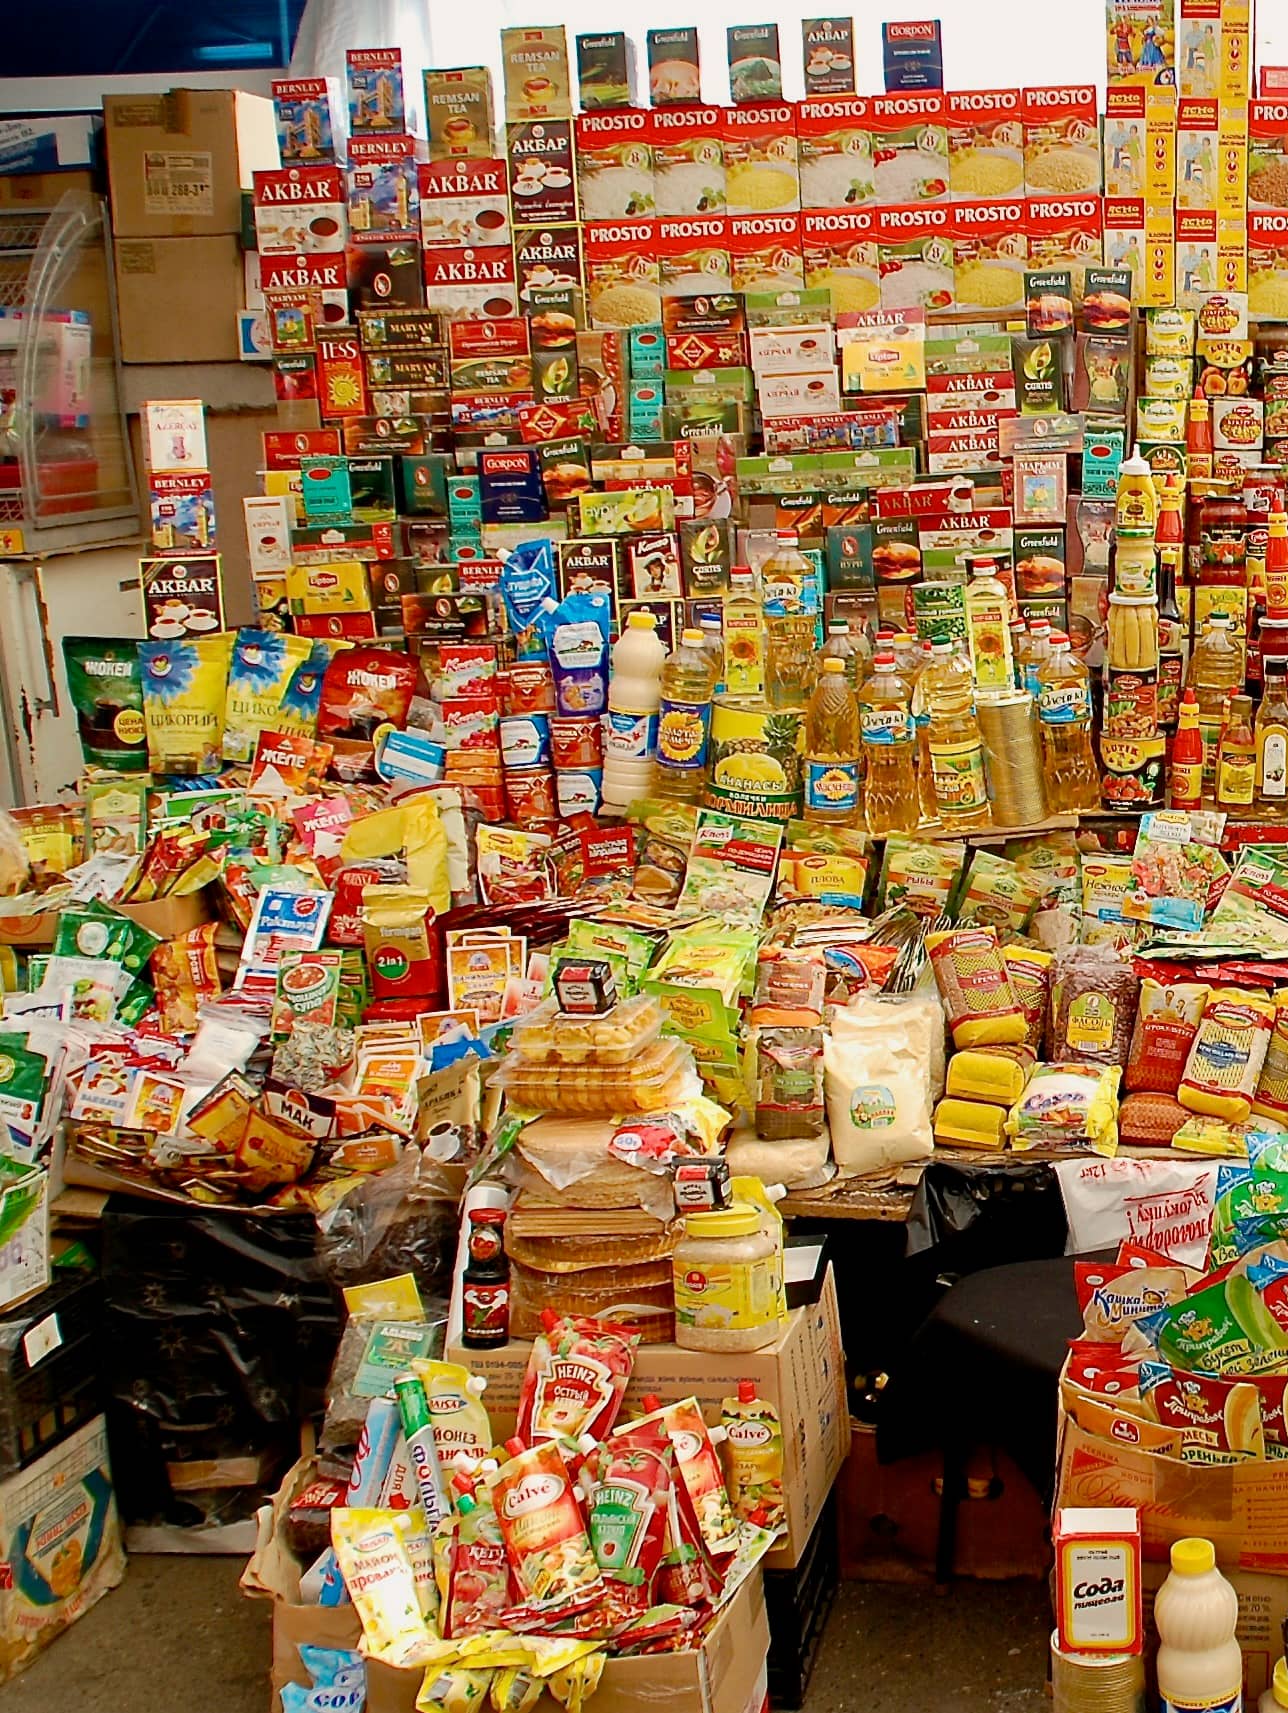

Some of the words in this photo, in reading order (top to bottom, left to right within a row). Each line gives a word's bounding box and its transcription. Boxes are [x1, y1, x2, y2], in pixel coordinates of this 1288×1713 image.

[890, 24, 933, 37] GORDON
[351, 52, 396, 63] BERNLEY
[511, 52, 560, 65] REMSAN
[526, 63, 547, 72] TEA
[276, 83, 321, 95] BERNLEY
[433, 92, 480, 104] REMSAN
[950, 94, 1017, 110] PROSTO
[1026, 89, 1094, 107] PROSTO
[448, 104, 468, 113] TEA
[801, 102, 867, 120] PROSTO
[874, 98, 941, 116] PROSTO
[654, 109, 717, 127] PROSTO
[727, 107, 791, 125] PROSTO
[583, 116, 645, 132] PROSTO
[351, 142, 410, 155] BERNLEY
[427, 172, 499, 193] AKBAR
[262, 180, 331, 201] AKBAR
[881, 209, 947, 226] PROSTO
[955, 207, 1022, 224] PROSTO
[1030, 201, 1096, 219] PROSTO
[661, 221, 724, 238] PROSTO
[732, 217, 797, 235] PROSTO
[805, 214, 872, 232] PROSTO
[590, 225, 653, 243] PROSTO
[519, 245, 577, 259] AKBAR
[269, 268, 338, 288] AKBAR
[434, 262, 509, 280] AKBAR
[1029, 275, 1066, 288] Greenfield
[1090, 273, 1127, 286] Greenfield
[857, 312, 907, 325] AKBAR
[321, 341, 357, 358] TESS
[947, 377, 996, 391] AKBAR
[949, 414, 999, 428] AKBAR
[681, 425, 724, 437] Greenfield
[949, 438, 999, 452] AKBAR
[487, 457, 527, 470] GORDON
[155, 478, 206, 488] BERNLEY
[876, 522, 913, 535] Greenfield
[940, 515, 989, 528] AKBAR
[1020, 536, 1058, 548] Greenfield
[567, 555, 609, 567] AKBAR
[148, 579, 213, 594] AKBAR
[310, 574, 336, 586] Lipton
[1023, 607, 1060, 617] Greenfield
[232, 701, 277, 715] ЦИКО
[150, 712, 219, 728] ЦИКОРИЙ
[261, 749, 305, 768] ЖЕЛЕ
[720, 775, 783, 791] АНАНАСЫ
[304, 811, 348, 832] ЖЕЛЕ
[378, 956, 385, 967] 2
[387, 957, 396, 966] in
[397, 957, 402, 966] 1
[280, 1101, 315, 1132] МАК
[558, 1364, 594, 1383] HEINZ
[729, 1425, 767, 1439] Calvé
[508, 1480, 552, 1508] Calvé
[597, 1490, 634, 1506] HEINZ
[1074, 1577, 1124, 1598] Сода
